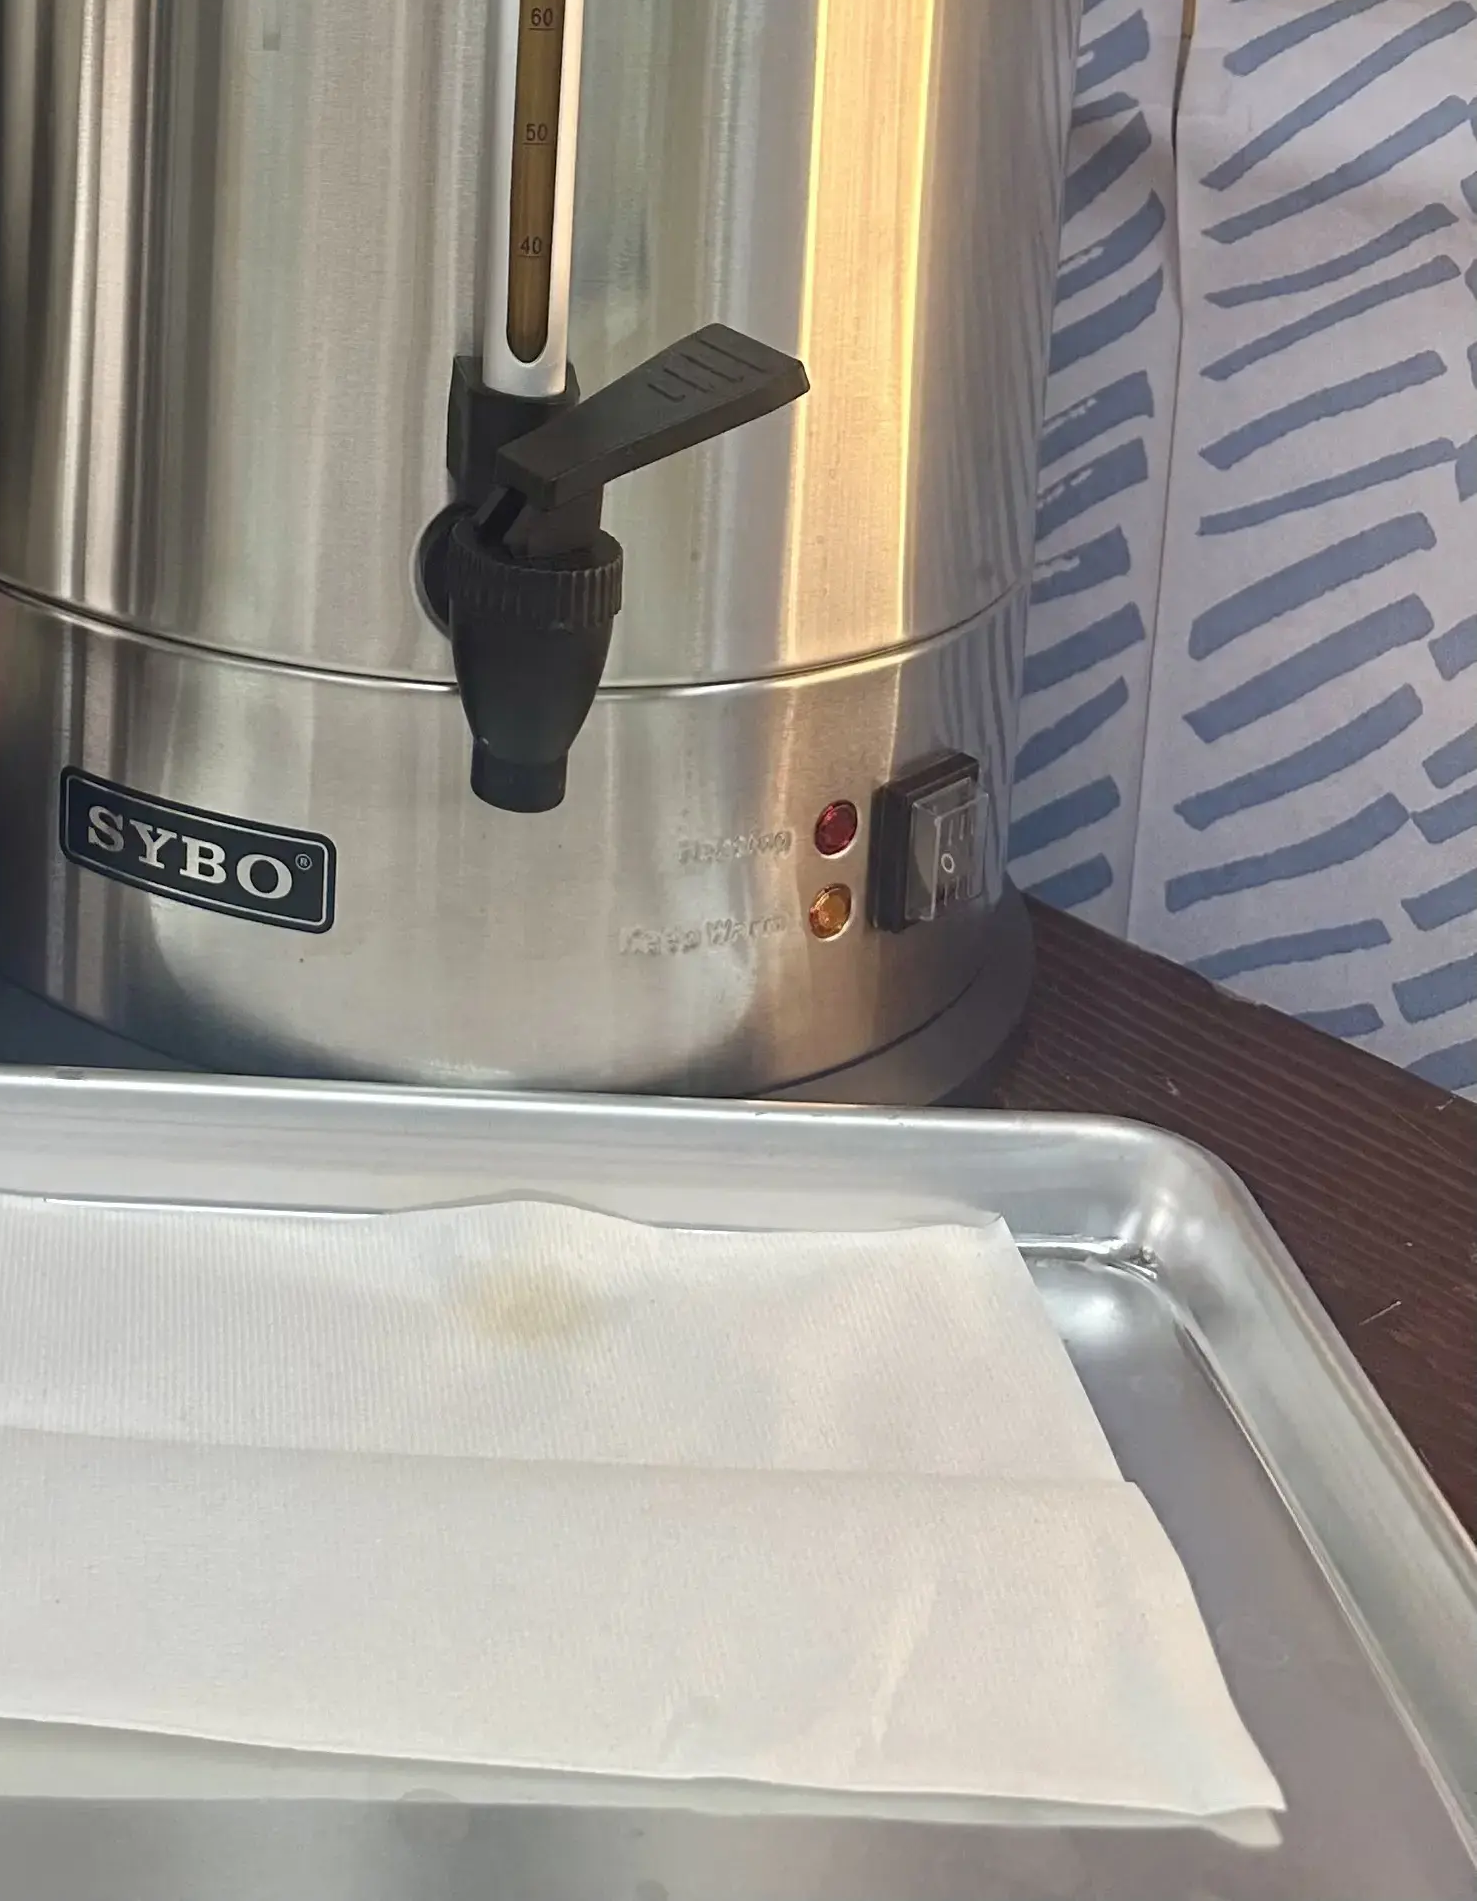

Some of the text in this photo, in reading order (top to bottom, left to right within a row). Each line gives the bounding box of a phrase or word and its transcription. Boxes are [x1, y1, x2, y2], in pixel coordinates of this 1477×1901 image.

[530, 7, 553, 28] 60
[525, 122, 548, 143] 50
[519, 236, 543, 256] 40
